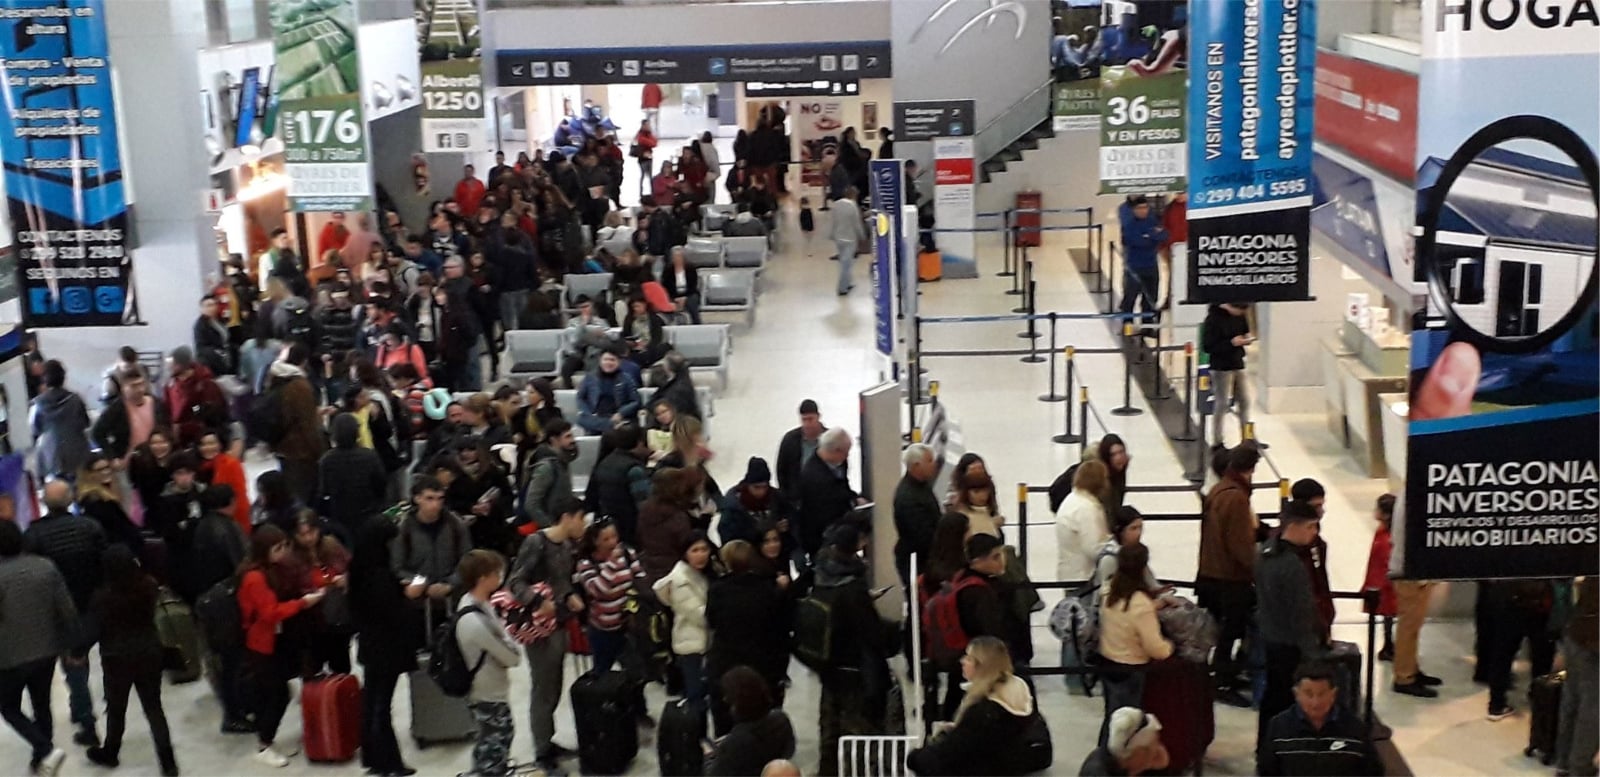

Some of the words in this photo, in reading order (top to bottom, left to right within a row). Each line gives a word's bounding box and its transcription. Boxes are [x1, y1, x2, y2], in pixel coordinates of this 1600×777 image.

[25, 23, 67, 35] altura
[62, 57, 105, 69] Venta
[1207, 43, 1224, 66] EN
[423, 74, 481, 88] Alberdi
[423, 91, 481, 110] 1250
[801, 103, 821, 114] NO
[1107, 95, 1150, 126] 36
[1205, 69, 1224, 160] VISITANOS
[295, 109, 361, 144] 176
[1120, 130, 1137, 142] EN
[1139, 128, 1181, 141] PESOS
[1207, 188, 1234, 203] 299
[1269, 178, 1306, 196] 5595
[1198, 234, 1298, 251] PATAGONIA
[1198, 250, 1298, 266] INVERSORES
[1198, 273, 1298, 286] INMOBILIARIOS
[1427, 460, 1599, 487] PATAGONIA
[1426, 487, 1599, 514] INVERSORES
[1426, 516, 1495, 528] SERVICIOS
[1496, 516, 1505, 527] Y
[1506, 513, 1598, 526] DESARROLLOS
[1425, 526, 1598, 547] INMOBILIARIOS
